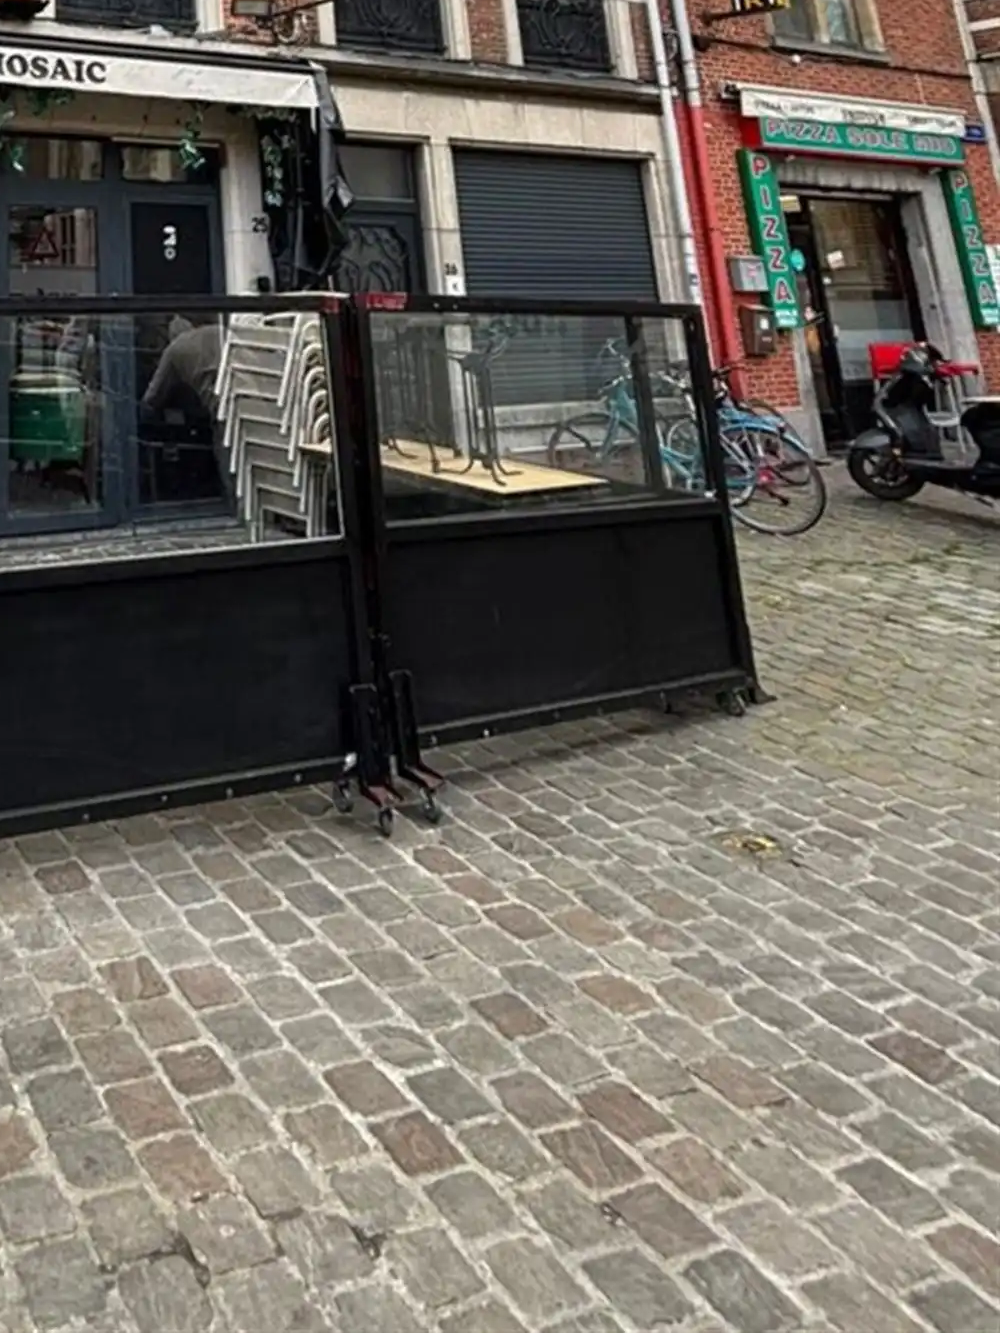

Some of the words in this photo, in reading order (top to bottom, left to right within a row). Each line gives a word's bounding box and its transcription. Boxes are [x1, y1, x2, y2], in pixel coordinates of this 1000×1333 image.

[766, 118, 841, 144] PIZZA
[847, 126, 908, 151] SOLE
[752, 155, 795, 304] PIZZA
[952, 171, 995, 304] PIZZA
